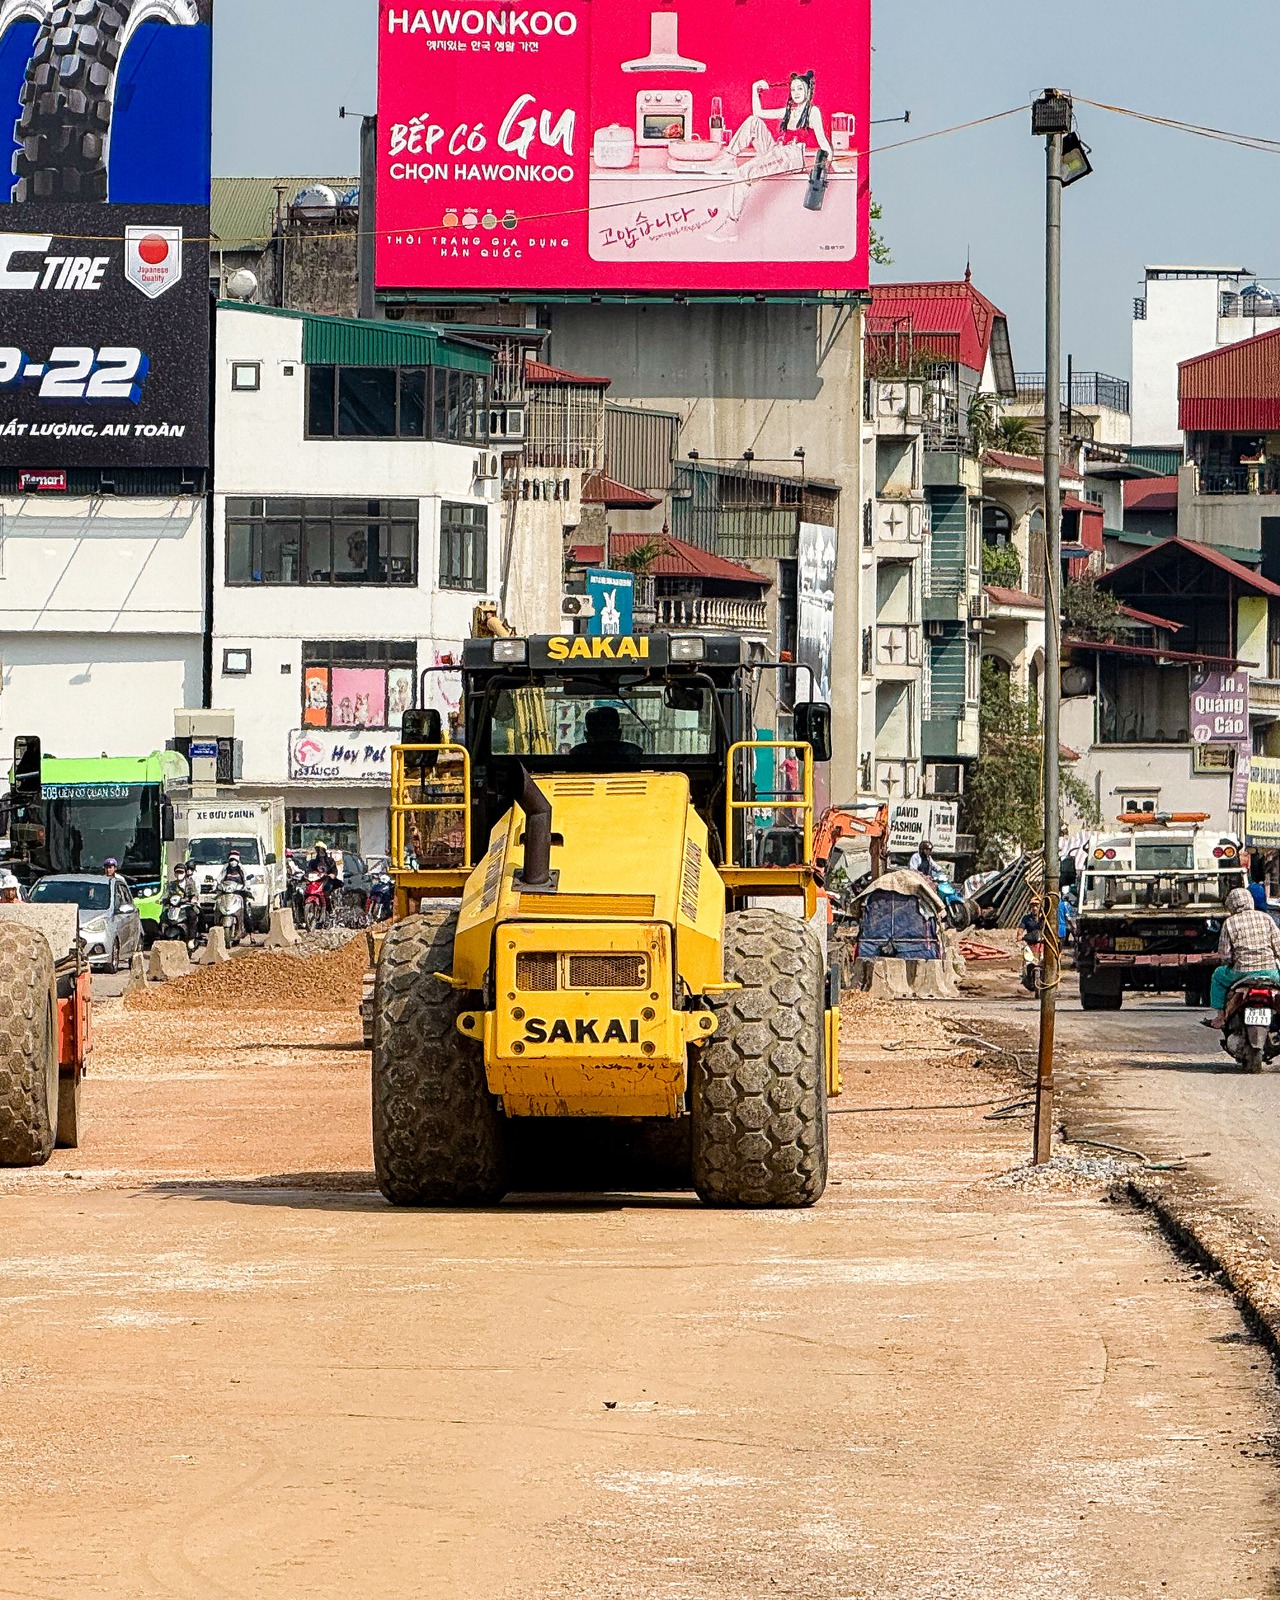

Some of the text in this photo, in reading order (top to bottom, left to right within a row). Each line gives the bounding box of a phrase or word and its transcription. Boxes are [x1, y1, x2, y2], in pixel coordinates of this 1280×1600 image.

[388, 10, 577, 35] HAWONKOO
[389, 163, 574, 183] CHỌN HAWONKOO
[432, 236, 481, 246] TRANG
[491, 237, 518, 246] GIA
[529, 238, 570, 249] DỤNG
[440, 246, 523, 259] HÀN QUỐC
[39, 256, 110, 290] TIRE
[137, 265, 169, 275] Japanese
[142, 274, 165, 284] Quality
[29, 422, 98, 440] LƯỢNG,
[100, 424, 128, 437] AN
[134, 420, 185, 437] TOÀN
[548, 636, 649, 660] SAKAI
[1220, 675, 1235, 692] In
[1195, 692, 1244, 715] Quảng
[1214, 716, 1244, 734] Cáo
[896, 806, 919, 818] DAVID
[890, 820, 922, 833] FASHION
[523, 1018, 640, 1044] SAKAI
